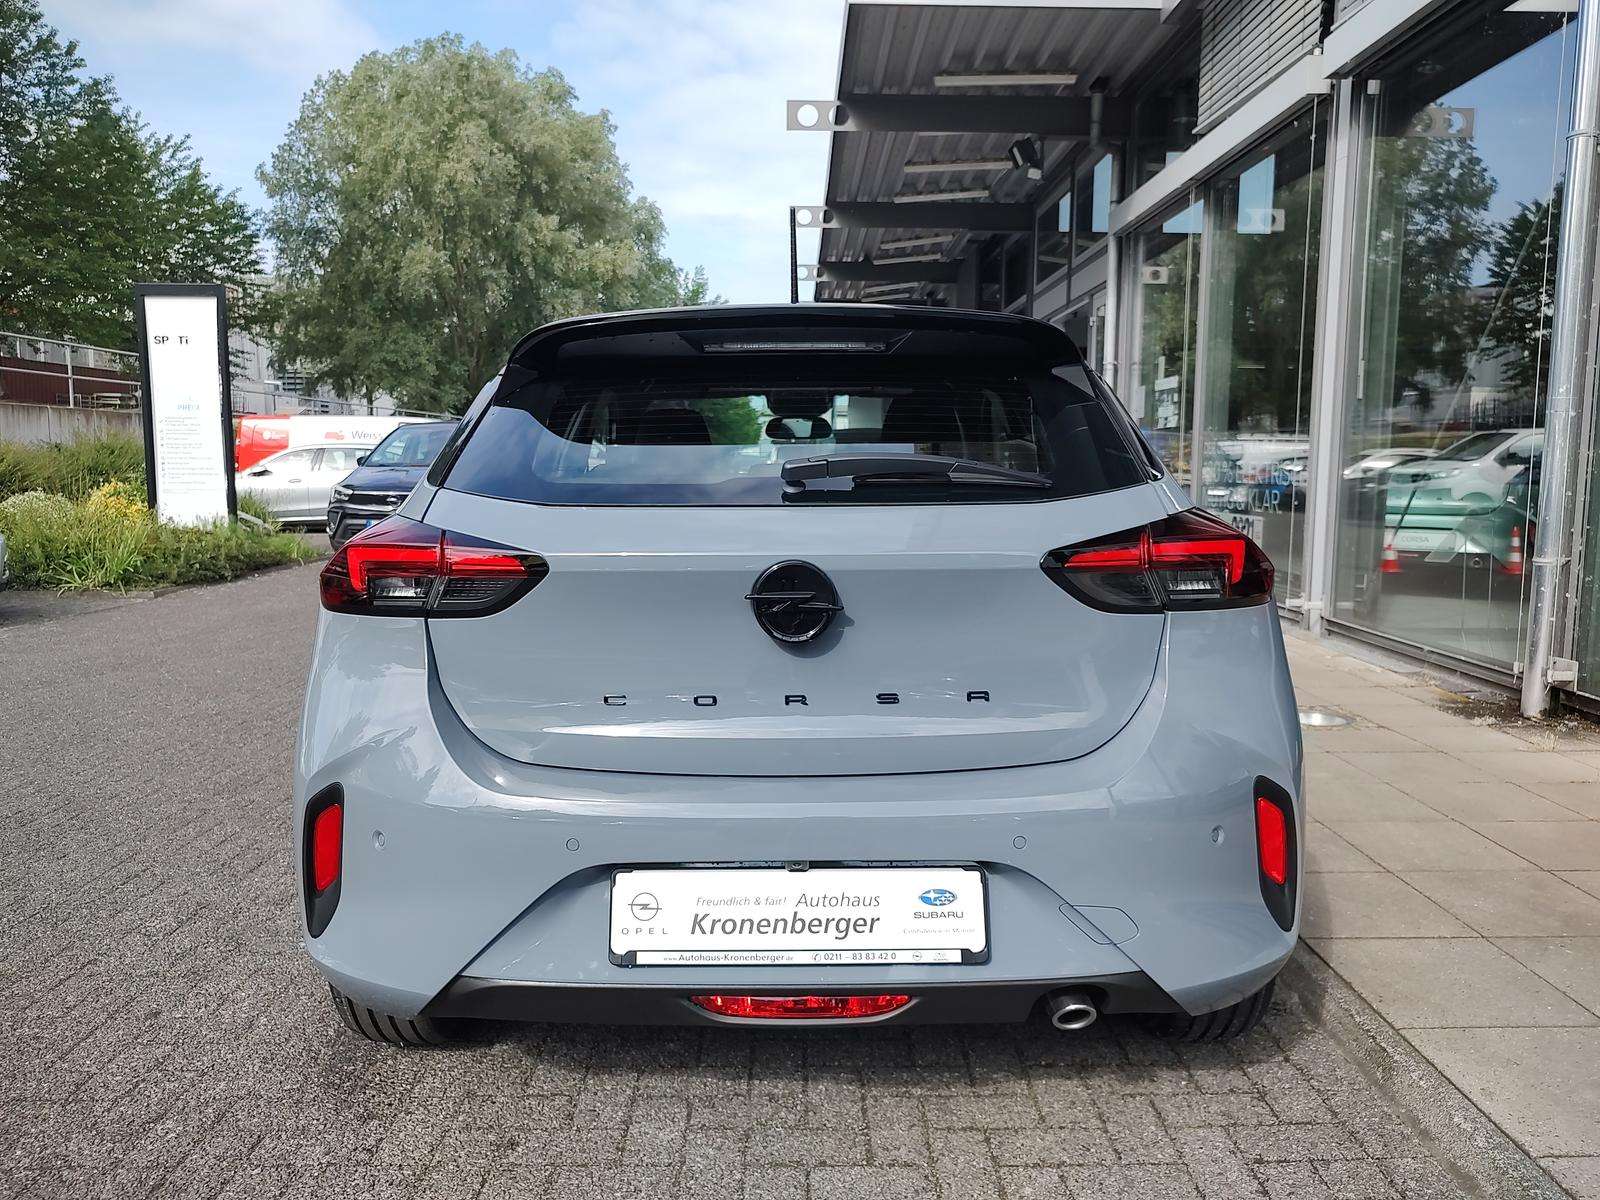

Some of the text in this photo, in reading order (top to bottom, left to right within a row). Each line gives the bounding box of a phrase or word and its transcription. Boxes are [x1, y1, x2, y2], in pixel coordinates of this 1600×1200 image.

[603, 690, 990, 706] CORSA
[696, 896, 787, 907] Freundlich & fair!
[796, 891, 881, 907] Autohaus
[913, 911, 964, 919] SUBARU
[621, 927, 669, 935] OPEL
[690, 911, 881, 940] Kronenberger
[823, 953, 842, 961] 0211
[852, 953, 863, 961] 83
[865, 953, 876, 961] 83
[890, 952, 897, 960] 0
